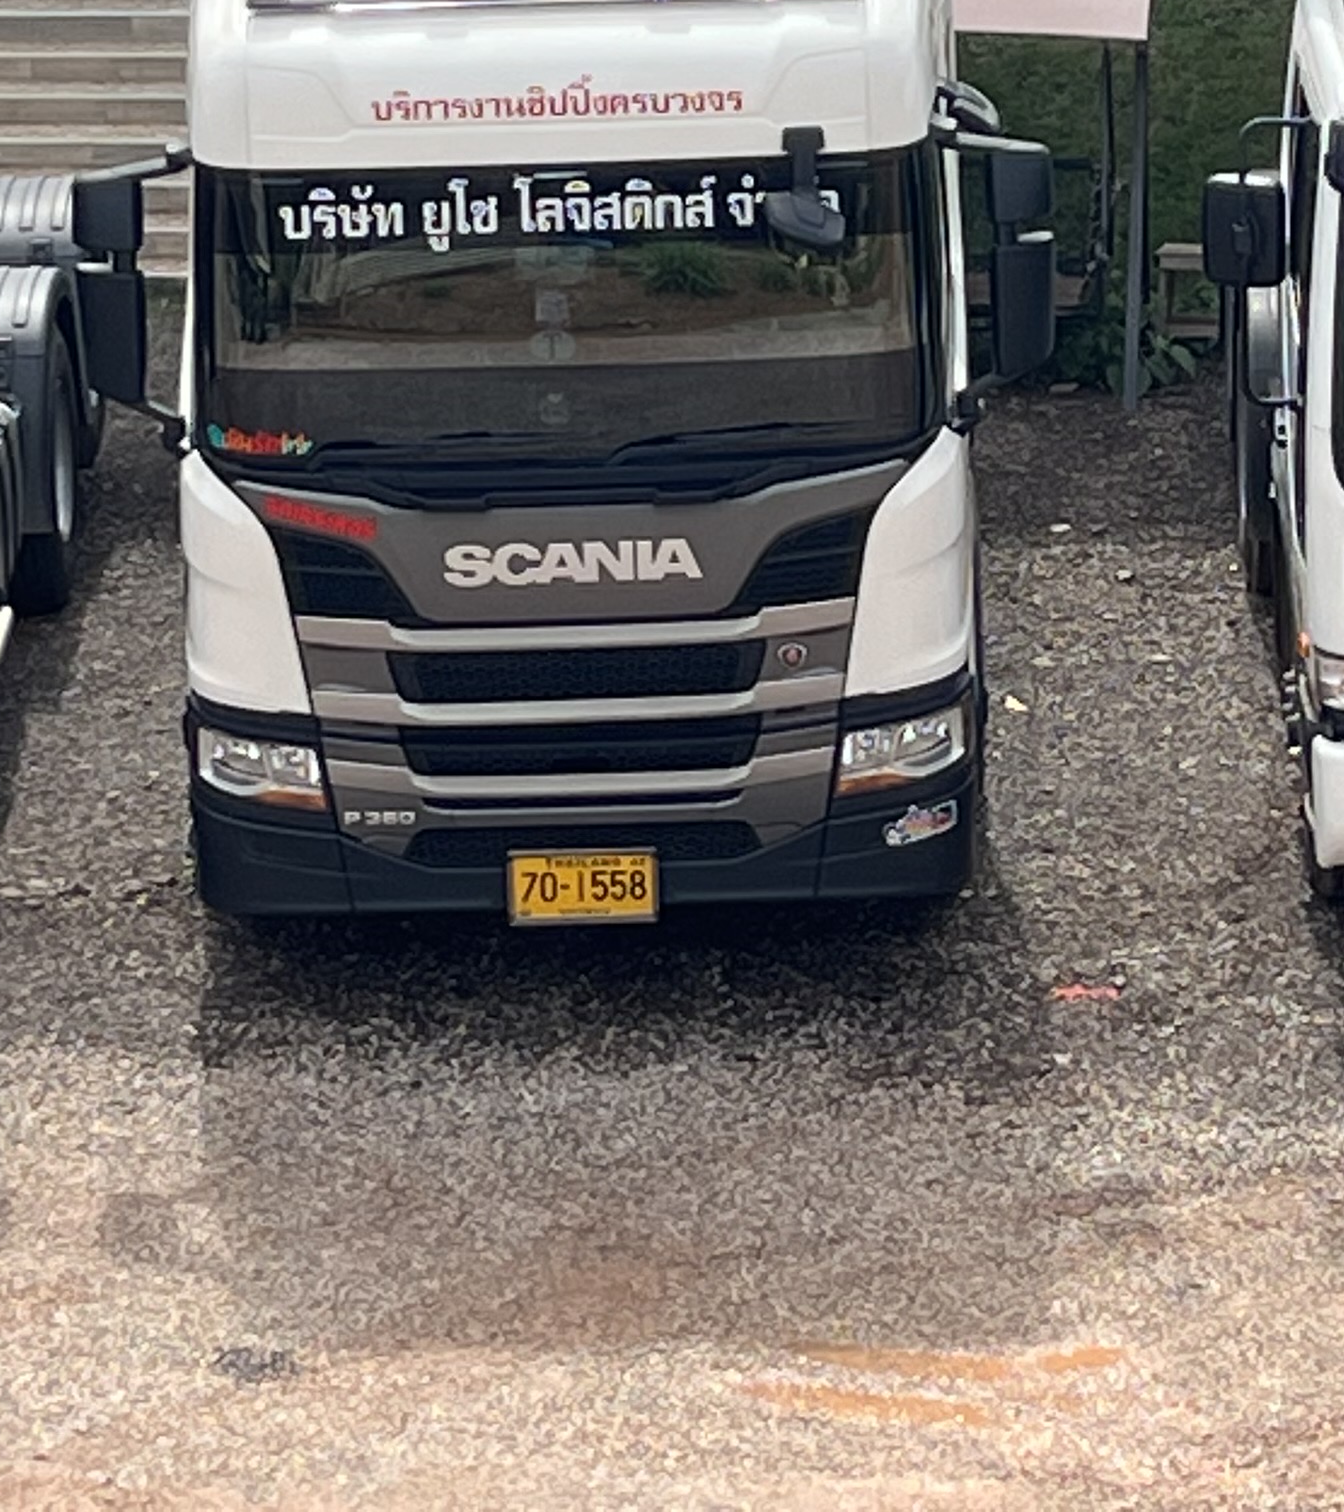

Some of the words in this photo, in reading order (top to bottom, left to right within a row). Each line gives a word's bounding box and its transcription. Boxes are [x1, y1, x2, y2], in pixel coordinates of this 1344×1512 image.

[278, 184, 404, 240] บริษัท
[513, 174, 715, 234] โลจิสติกส์
[442, 537, 704, 588] SCANIA
[520, 869, 647, 904] 70-1558
